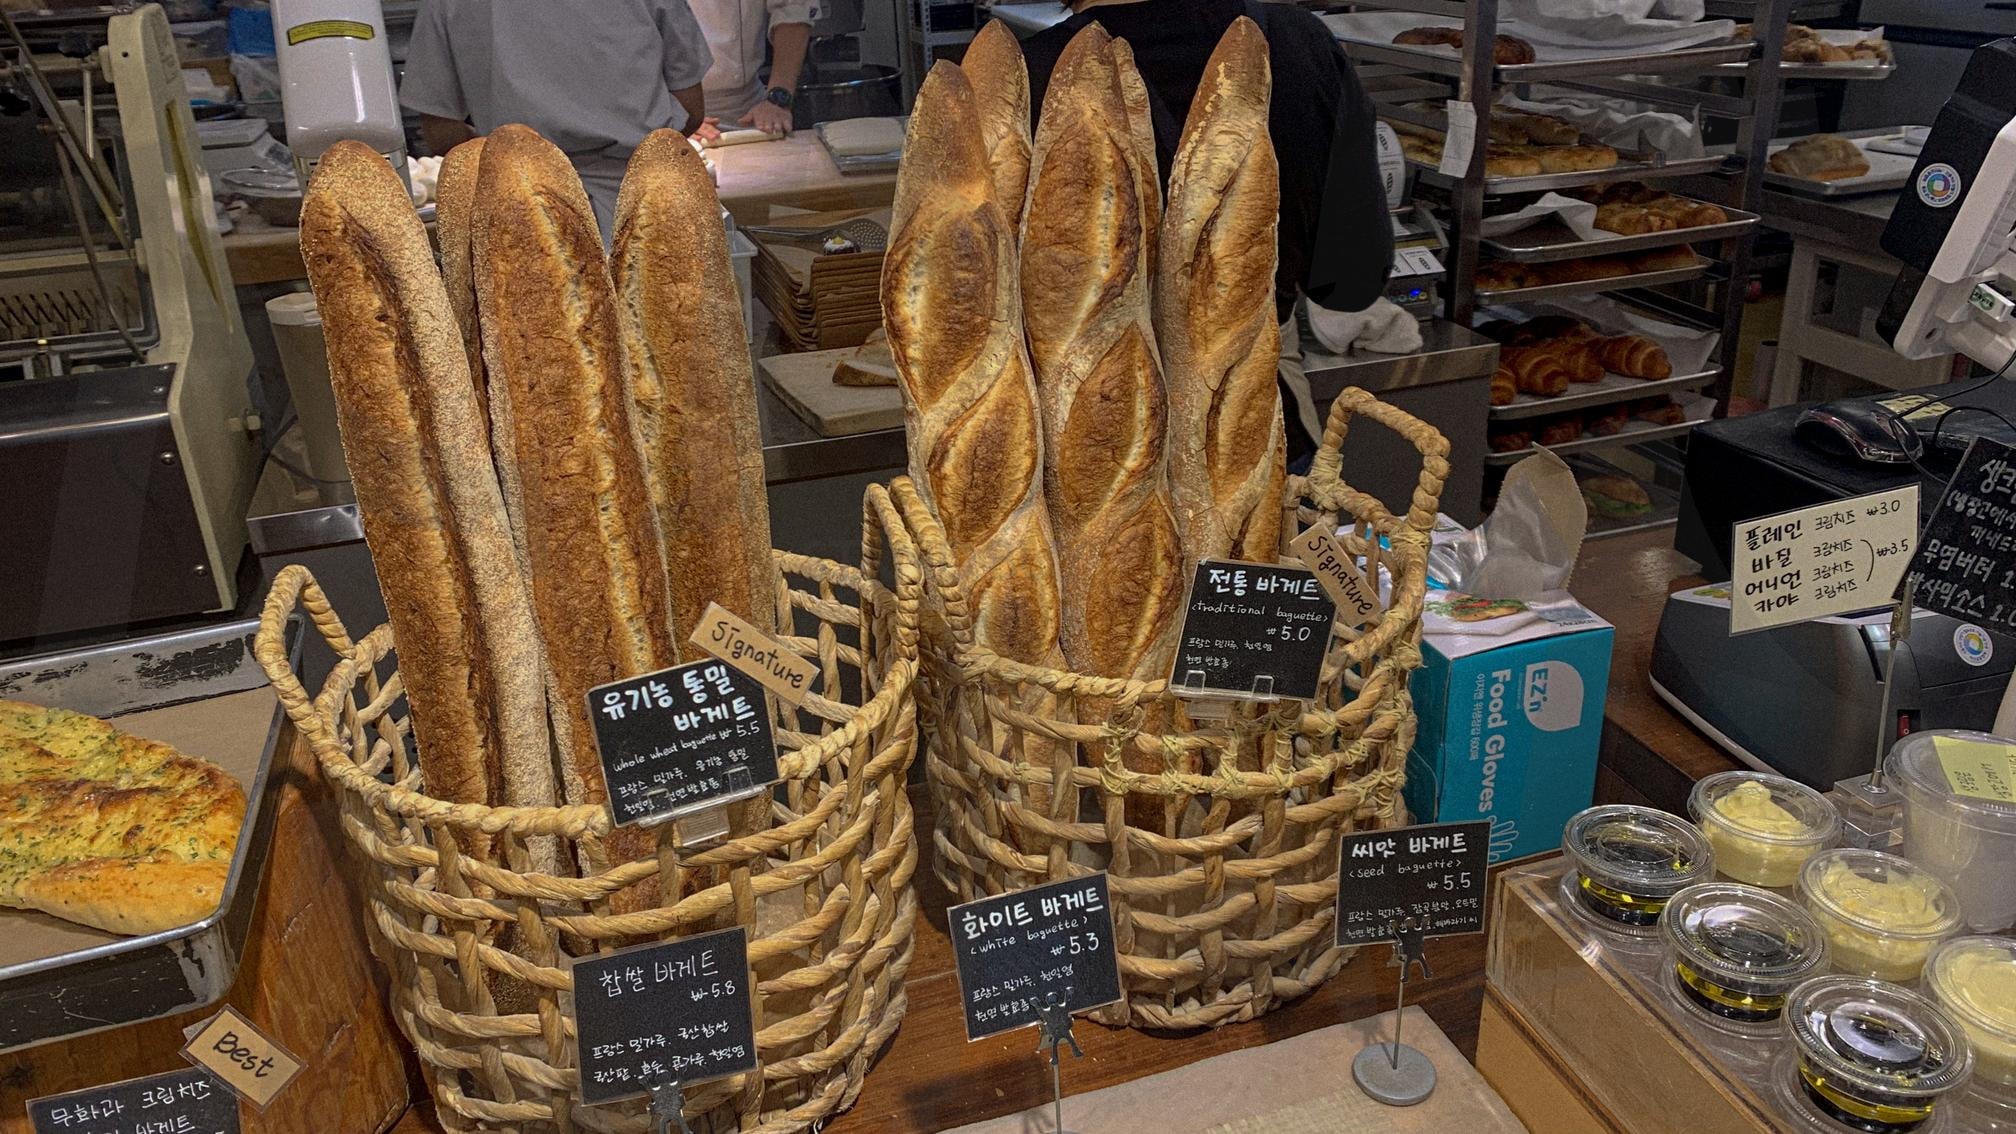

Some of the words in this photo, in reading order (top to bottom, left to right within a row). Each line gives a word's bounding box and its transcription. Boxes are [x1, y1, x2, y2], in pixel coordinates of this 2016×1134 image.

[1745, 519, 1803, 551] 플레인
[1815, 510, 1855, 531] 크림치즈
[1308, 535, 1373, 616] Signature
[1752, 547, 1792, 573] 바질
[1813, 539, 1853, 558] 크림치즈
[1923, 538, 1997, 583] 무염버터
[1209, 569, 1248, 596] 전통
[1256, 575, 1320, 600] 바게트
[1745, 570, 1802, 596] 어니언
[1812, 561, 1855, 581] 크림치즈
[1754, 592, 1800, 613] 카야
[1814, 580, 1858, 600] 크림치즈
[712, 621, 804, 689] Signature
[603, 681, 673, 720] 유기농
[683, 665, 735, 703] 통밀
[1488, 668, 1512, 729] Food
[673, 697, 755, 731] 바게트
[613, 755, 646, 772] whole
[649, 742, 677, 760] wheat
[680, 733, 716, 750] baguette
[618, 780, 649, 798] 프랑스
[1478, 734, 1506, 813] Gloves
[1352, 838, 1397, 858] 씨앗
[1409, 832, 1467, 853] 바게트
[962, 902, 1033, 939] 화이트
[1041, 887, 1104, 916] 바게트
[599, 965, 645, 998] 찹쌀
[654, 950, 719, 983] 바게트
[973, 985, 1001, 1002] 프랑스
[1040, 963, 1075, 982] 천일염
[213, 1031, 274, 1078] Best
[592, 1042, 624, 1060] 프랑스
[51, 1099, 125, 1127] 무화과
[142, 1080, 211, 1110] 크림치즈
